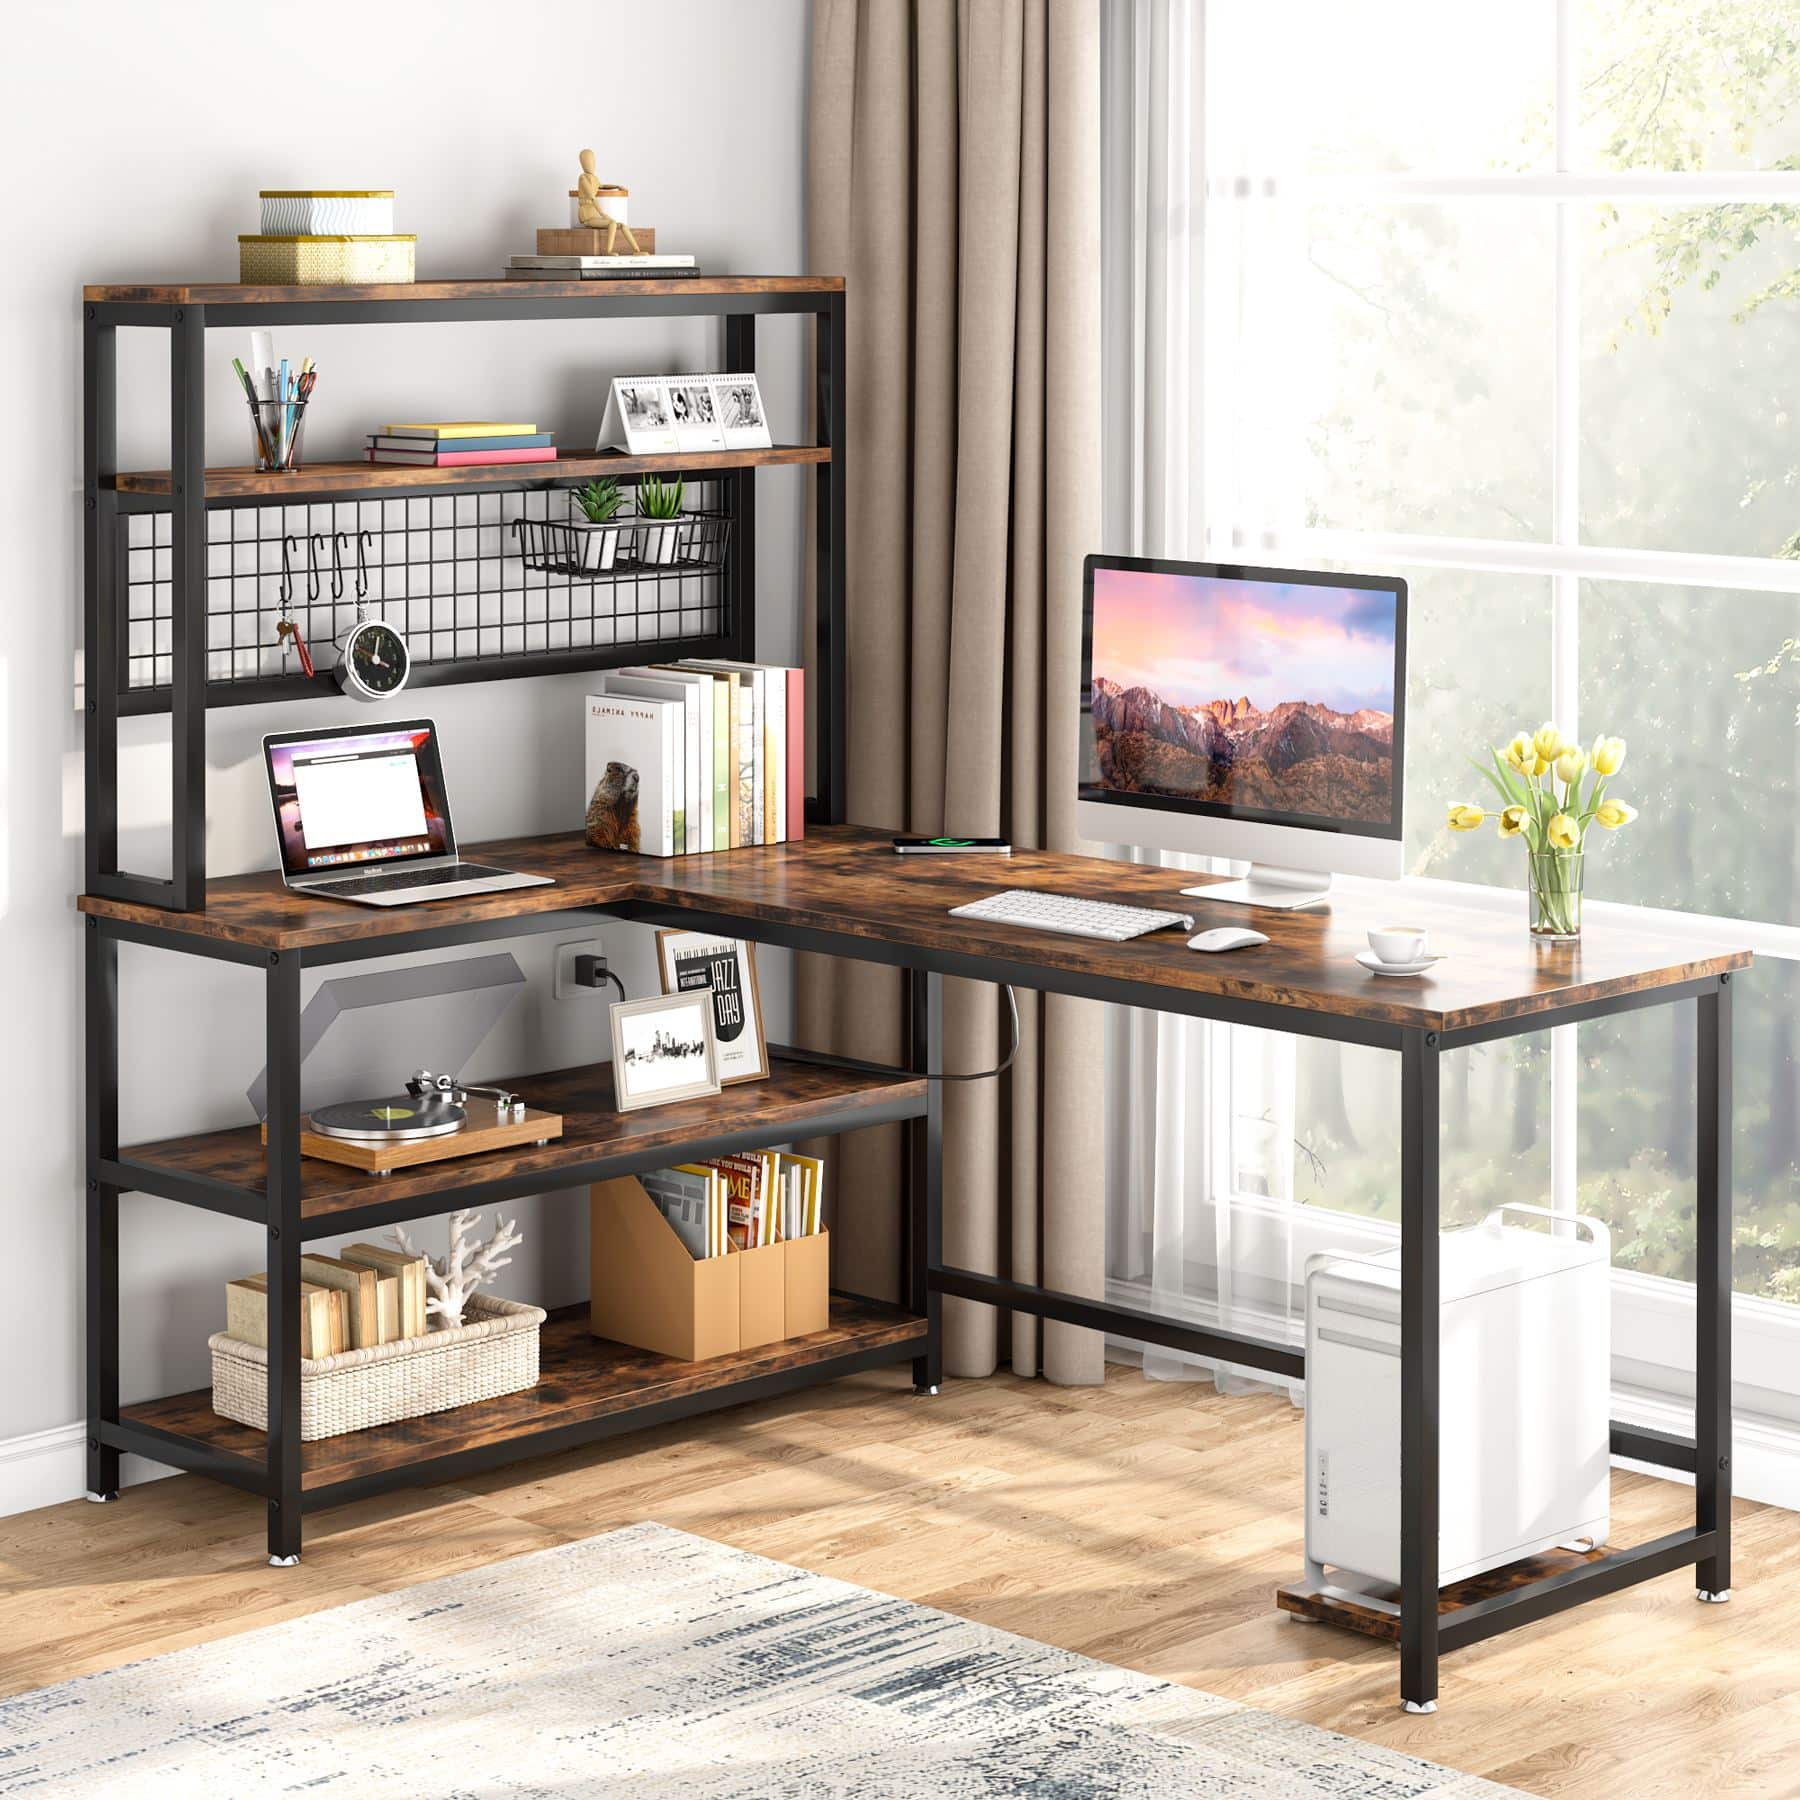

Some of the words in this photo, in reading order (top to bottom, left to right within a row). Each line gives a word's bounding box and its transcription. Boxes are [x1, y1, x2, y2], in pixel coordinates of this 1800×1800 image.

[710, 958, 737, 992] JAZZ
[717, 992, 741, 1026] DAY
[721, 1159, 733, 1169] YOU
[734, 1162, 752, 1173] BUILD
